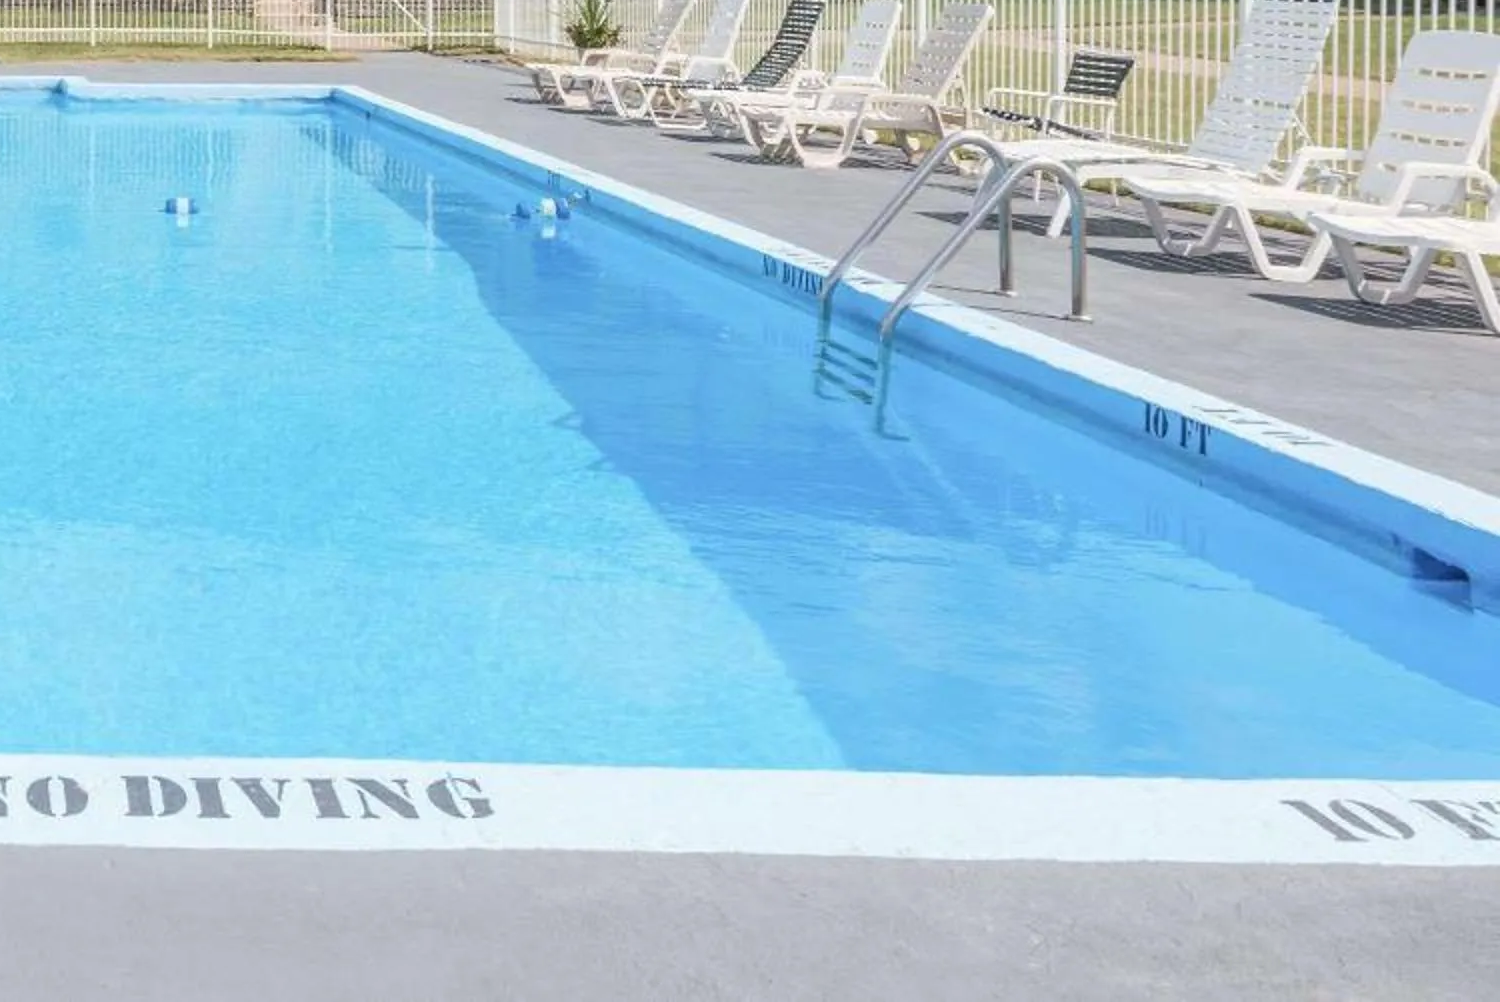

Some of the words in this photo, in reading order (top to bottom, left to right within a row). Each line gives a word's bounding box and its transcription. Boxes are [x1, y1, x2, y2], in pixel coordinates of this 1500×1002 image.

[1144, 402, 1169, 439] 10
[1180, 414, 1213, 456] FT
[120, 774, 496, 819] DIVING
[1278, 798, 1415, 842] 10
[1408, 799, 1500, 841] F
